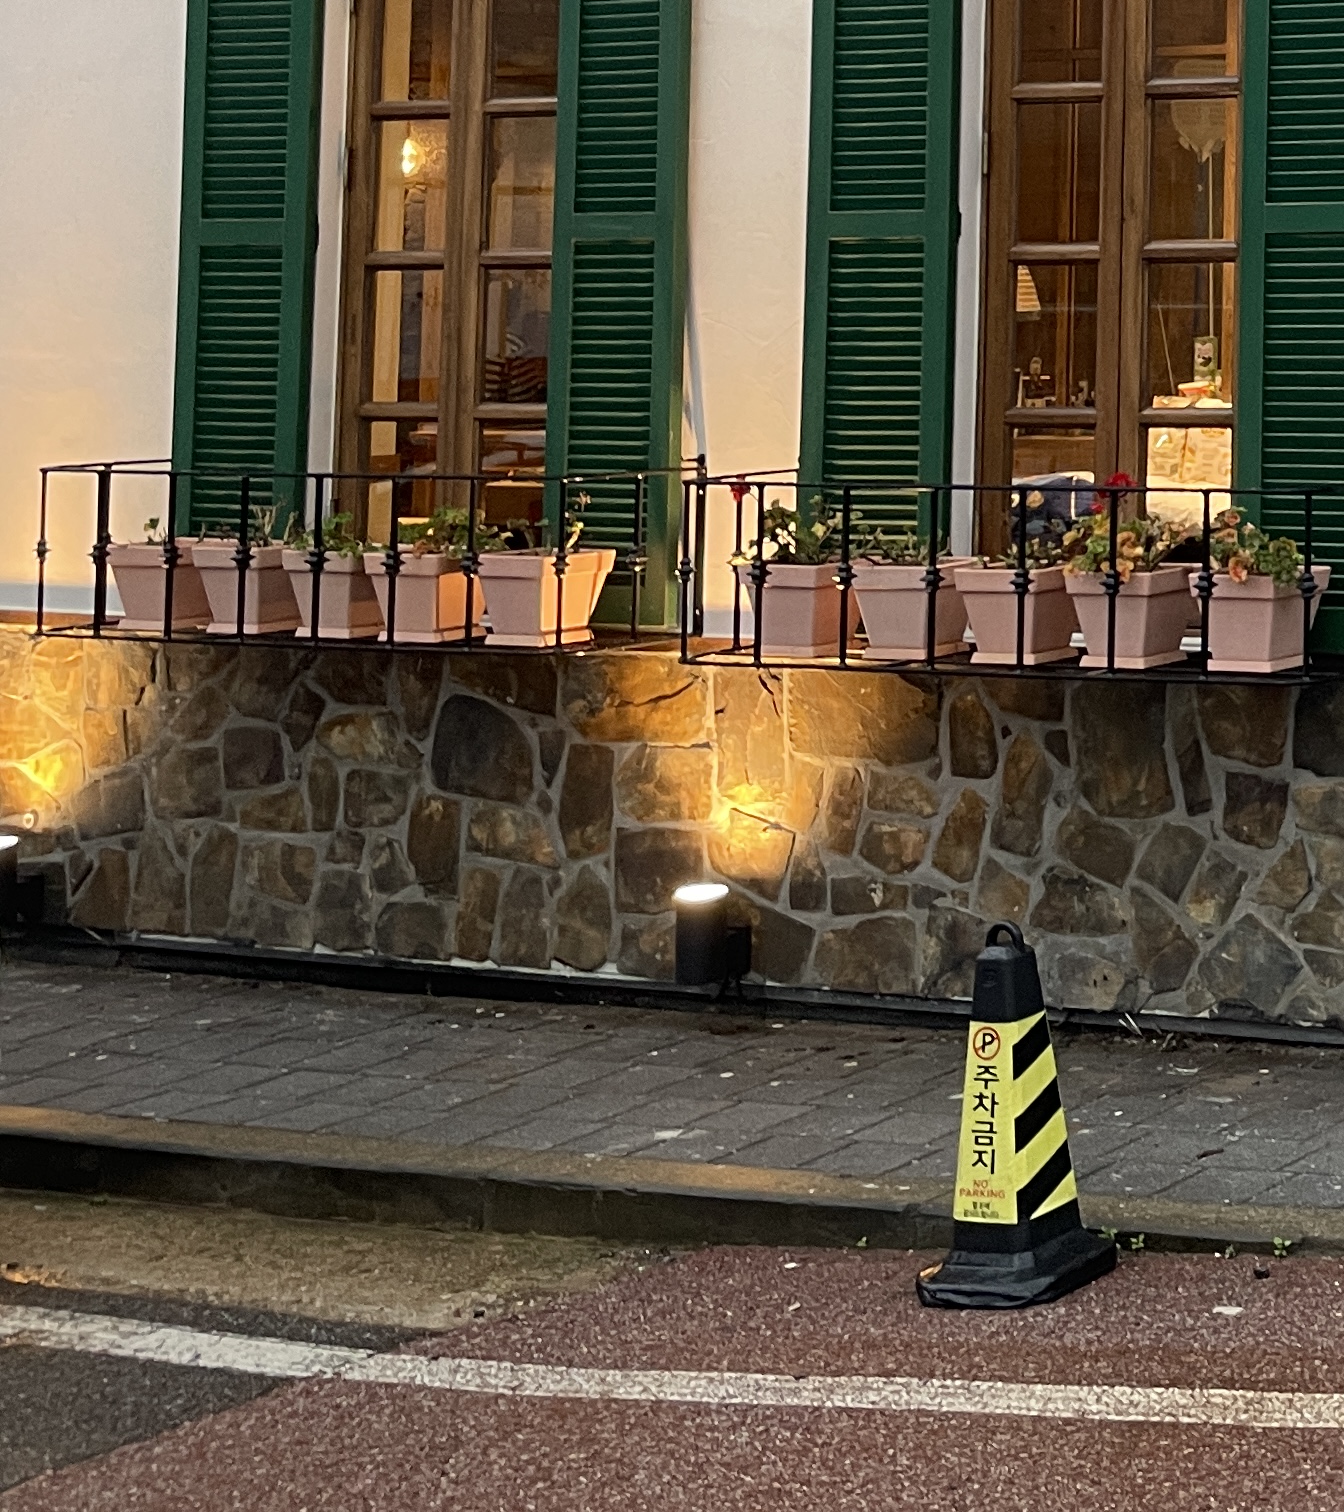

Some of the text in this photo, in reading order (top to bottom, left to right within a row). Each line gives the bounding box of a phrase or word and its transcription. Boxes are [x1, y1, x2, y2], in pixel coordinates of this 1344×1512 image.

[971, 1065, 1000, 1175] 주차금지
[973, 1179, 988, 1189] NO
[959, 1188, 1006, 1199] PARKING
